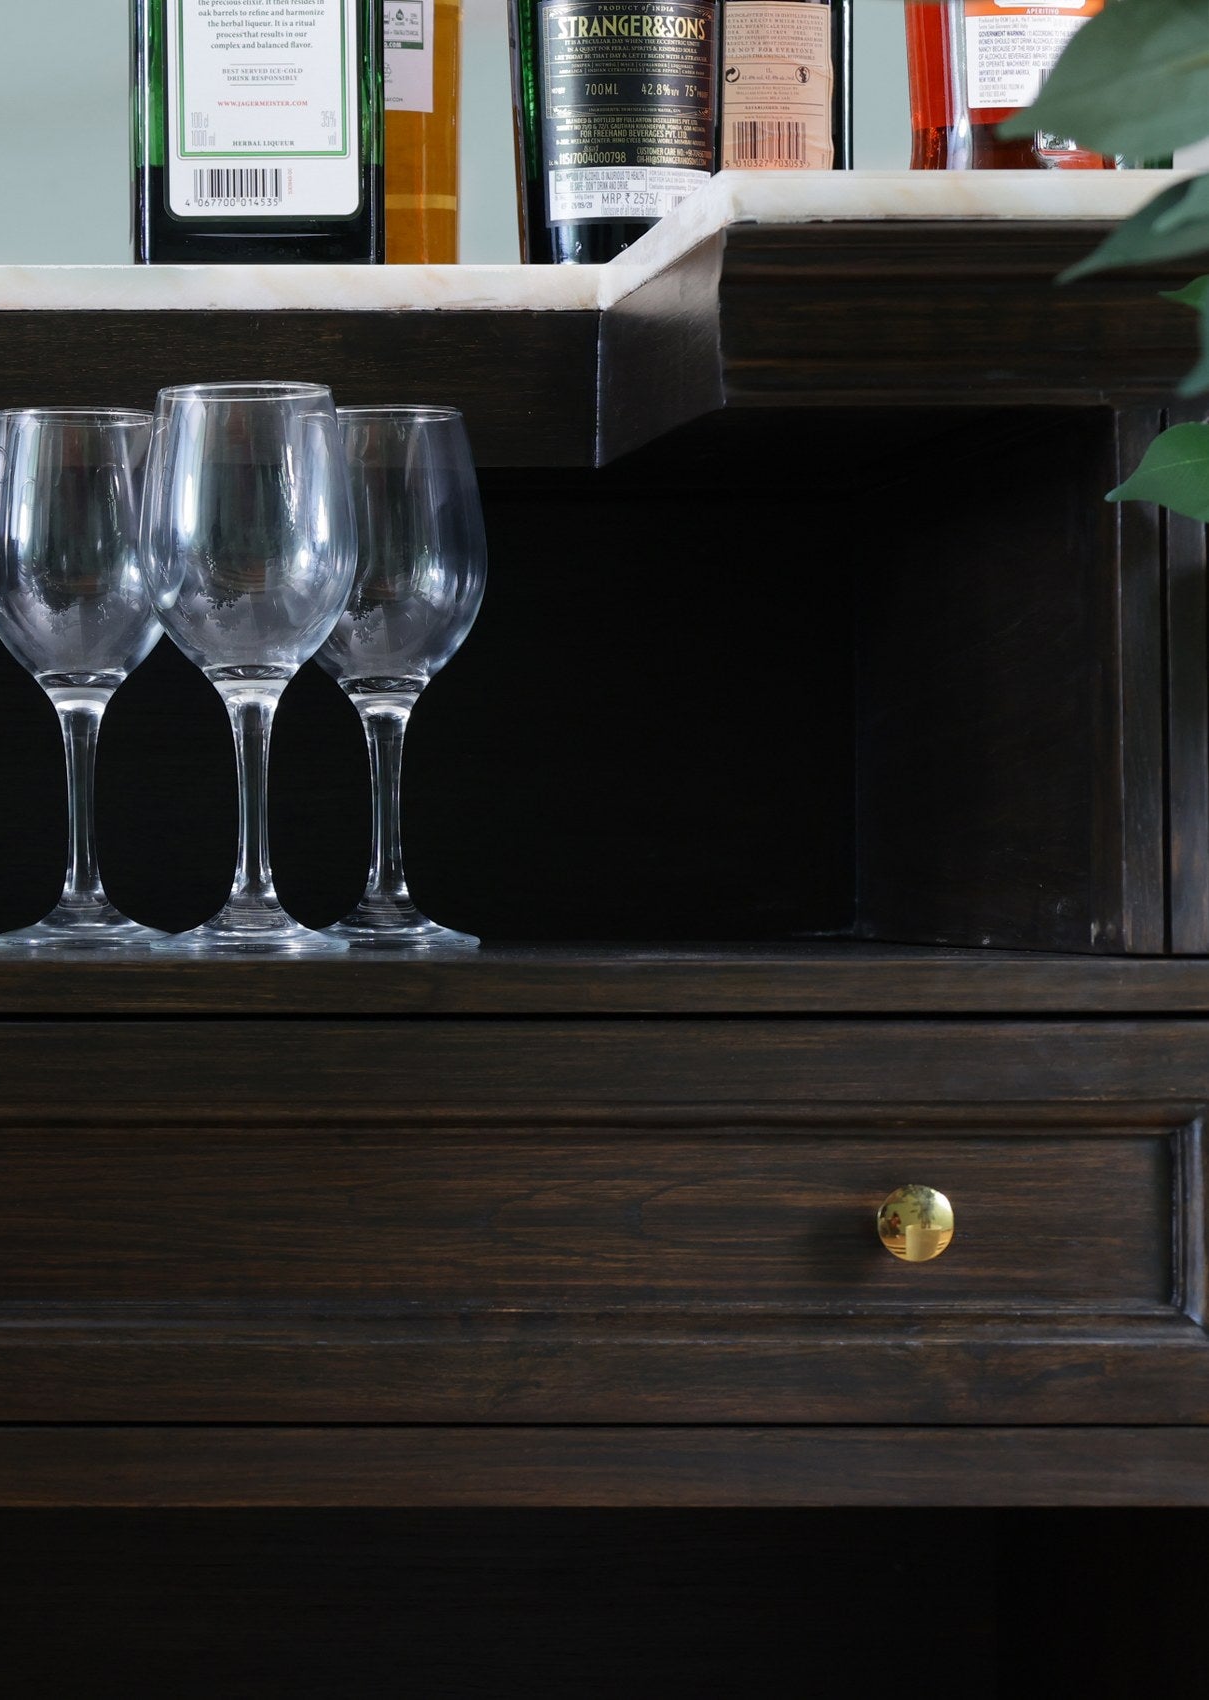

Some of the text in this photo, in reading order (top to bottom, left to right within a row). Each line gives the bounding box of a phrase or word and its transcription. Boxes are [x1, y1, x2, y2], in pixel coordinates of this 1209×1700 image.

[198, 8, 212, 16] oak
[212, 8, 238, 16] barrels
[286, 8, 324, 16] harmonize
[641, 4, 650, 12] of
[208, 19, 220, 27] the
[220, 19, 244, 27] herbal
[245, 19, 272, 28] liqueur.
[558, 14, 706, 40] STRANGER&SONS
[216, 32, 243, 40] process
[210, 42, 240, 50] complex
[585, 84, 619, 96] 700ML
[192, 112, 202, 128] 100
[321, 111, 336, 128] 35%
[664, 148, 676, 156] CARE
[584, 172, 600, 180] ALCOHOL
[597, 181, 608, 190] DRINK
[198, 198, 236, 206] 067700
[240, 198, 278, 206] 014535
[634, 192, 661, 205] 2575/-
